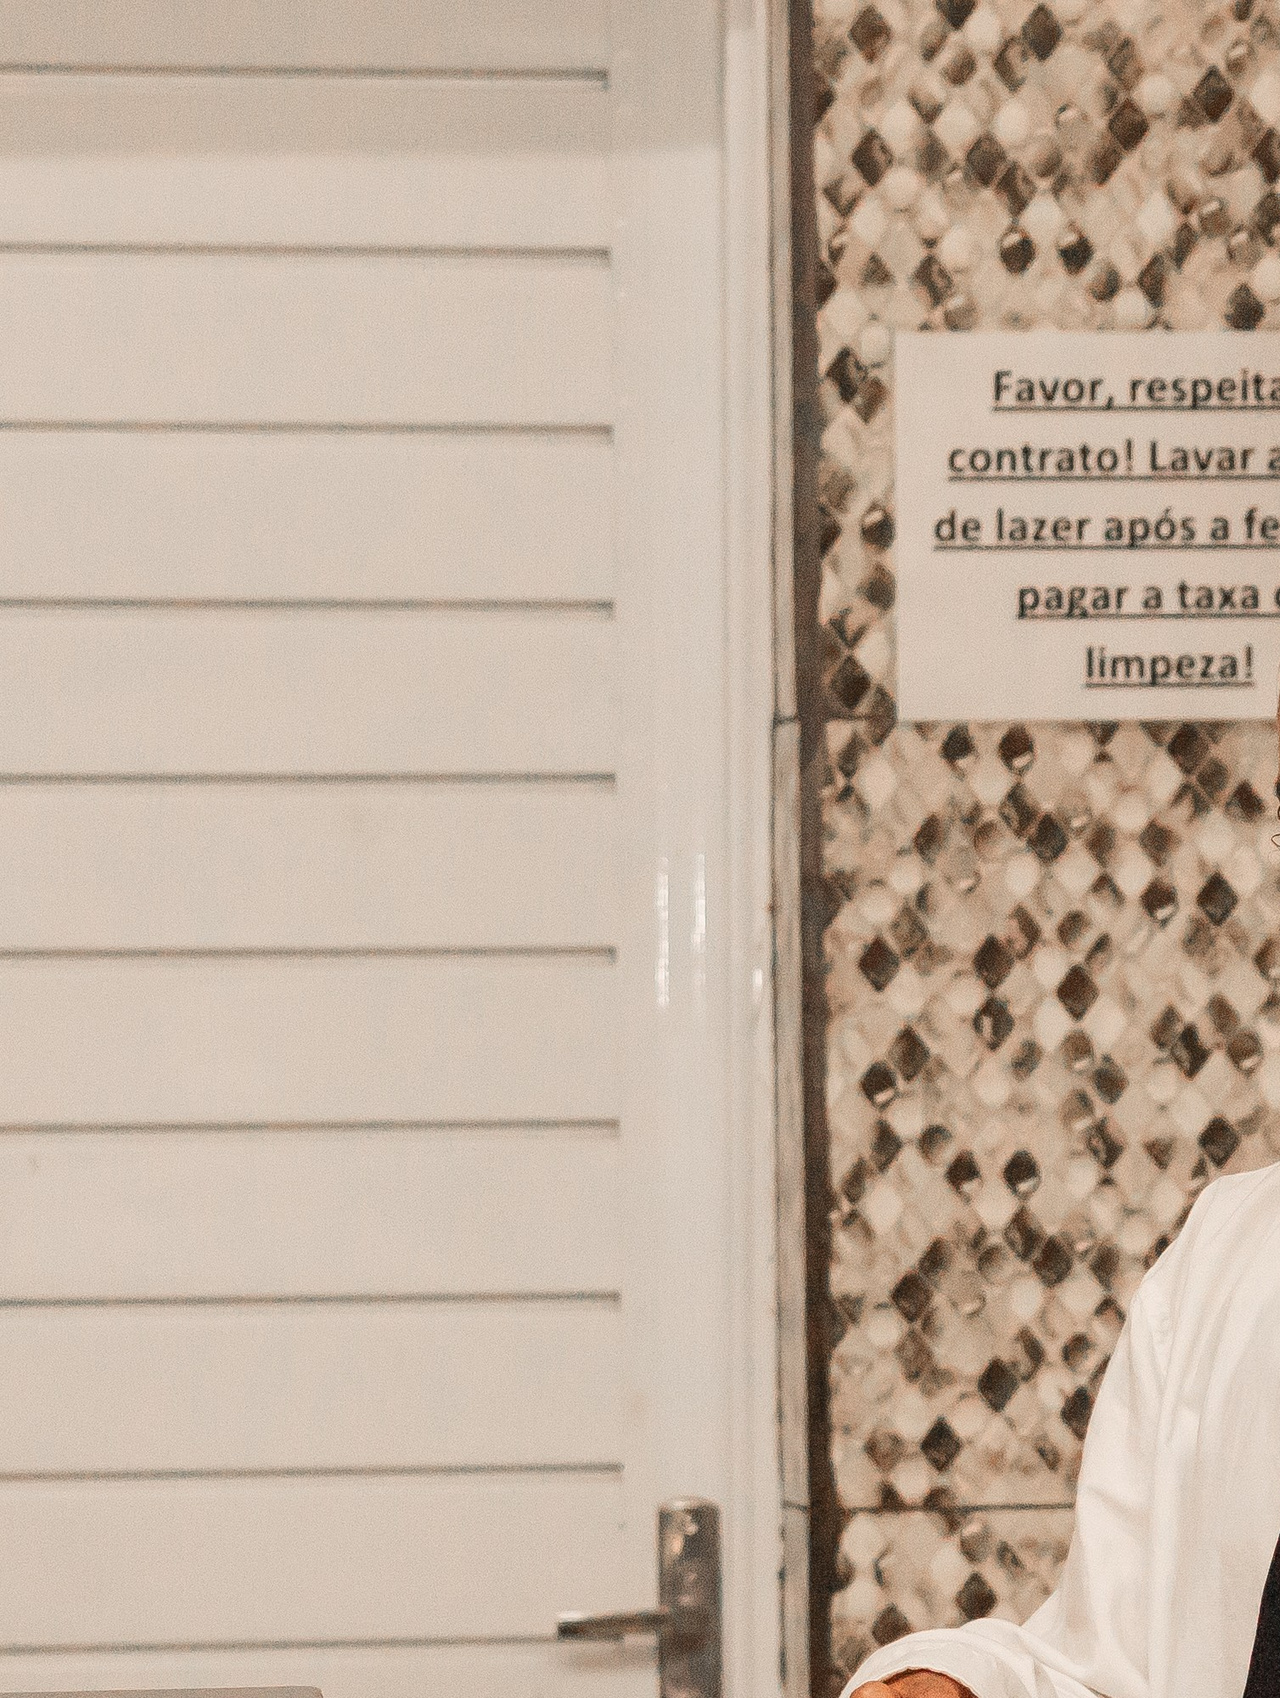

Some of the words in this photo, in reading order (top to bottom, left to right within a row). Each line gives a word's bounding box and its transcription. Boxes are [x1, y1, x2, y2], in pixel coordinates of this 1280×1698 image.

[993, 370, 1115, 408] Favor,
[948, 438, 1134, 472] contrato!
[1149, 441, 1254, 472] Lavar
[934, 508, 982, 542] de
[996, 508, 1090, 541] lazer
[1104, 508, 1196, 549] após
[1209, 517, 1231, 541] a
[1018, 586, 1129, 619] pagar
[1142, 586, 1164, 610] a
[1177, 580, 1260, 610] taxa
[1086, 646, 1254, 687] limpeza!
